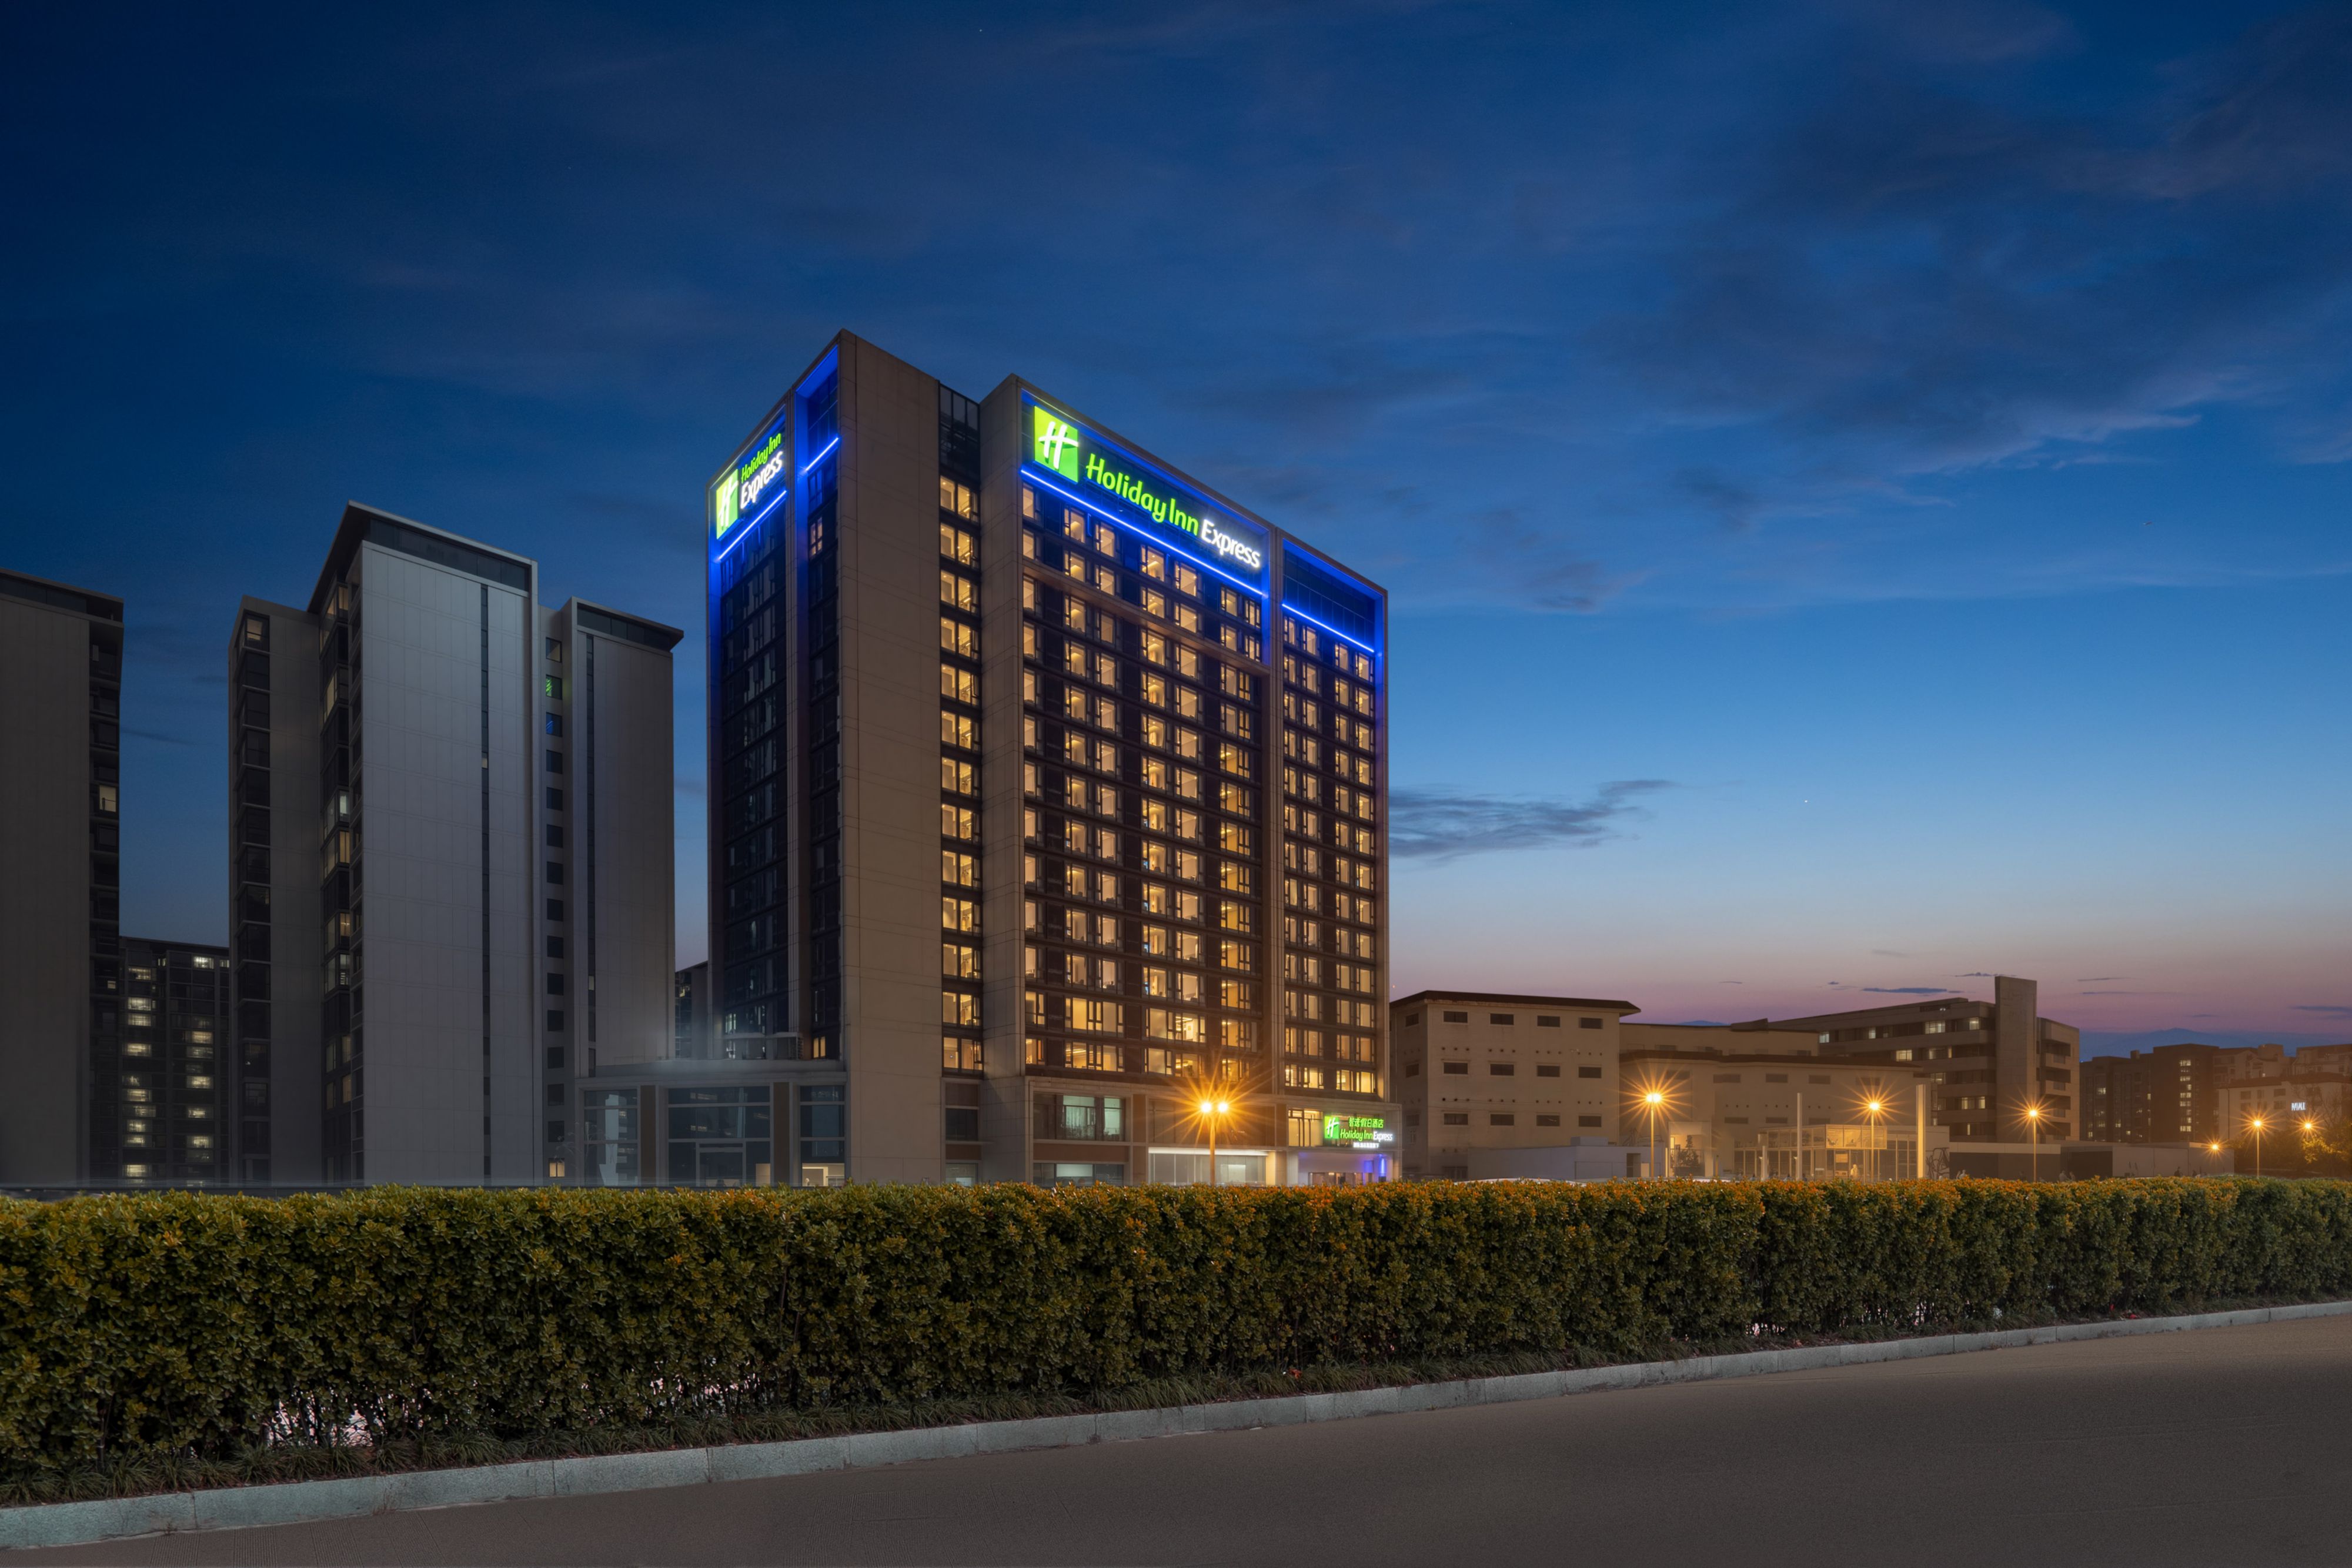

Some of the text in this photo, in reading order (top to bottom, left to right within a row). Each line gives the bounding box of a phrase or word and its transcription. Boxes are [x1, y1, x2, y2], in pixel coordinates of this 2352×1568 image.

[740, 450, 783, 509] Express
[741, 433, 781, 483] Holiday Inn
[1086, 453, 1261, 568] Holiday Inn Express
[1340, 1129, 1393, 1142] Holiday Inn Express
